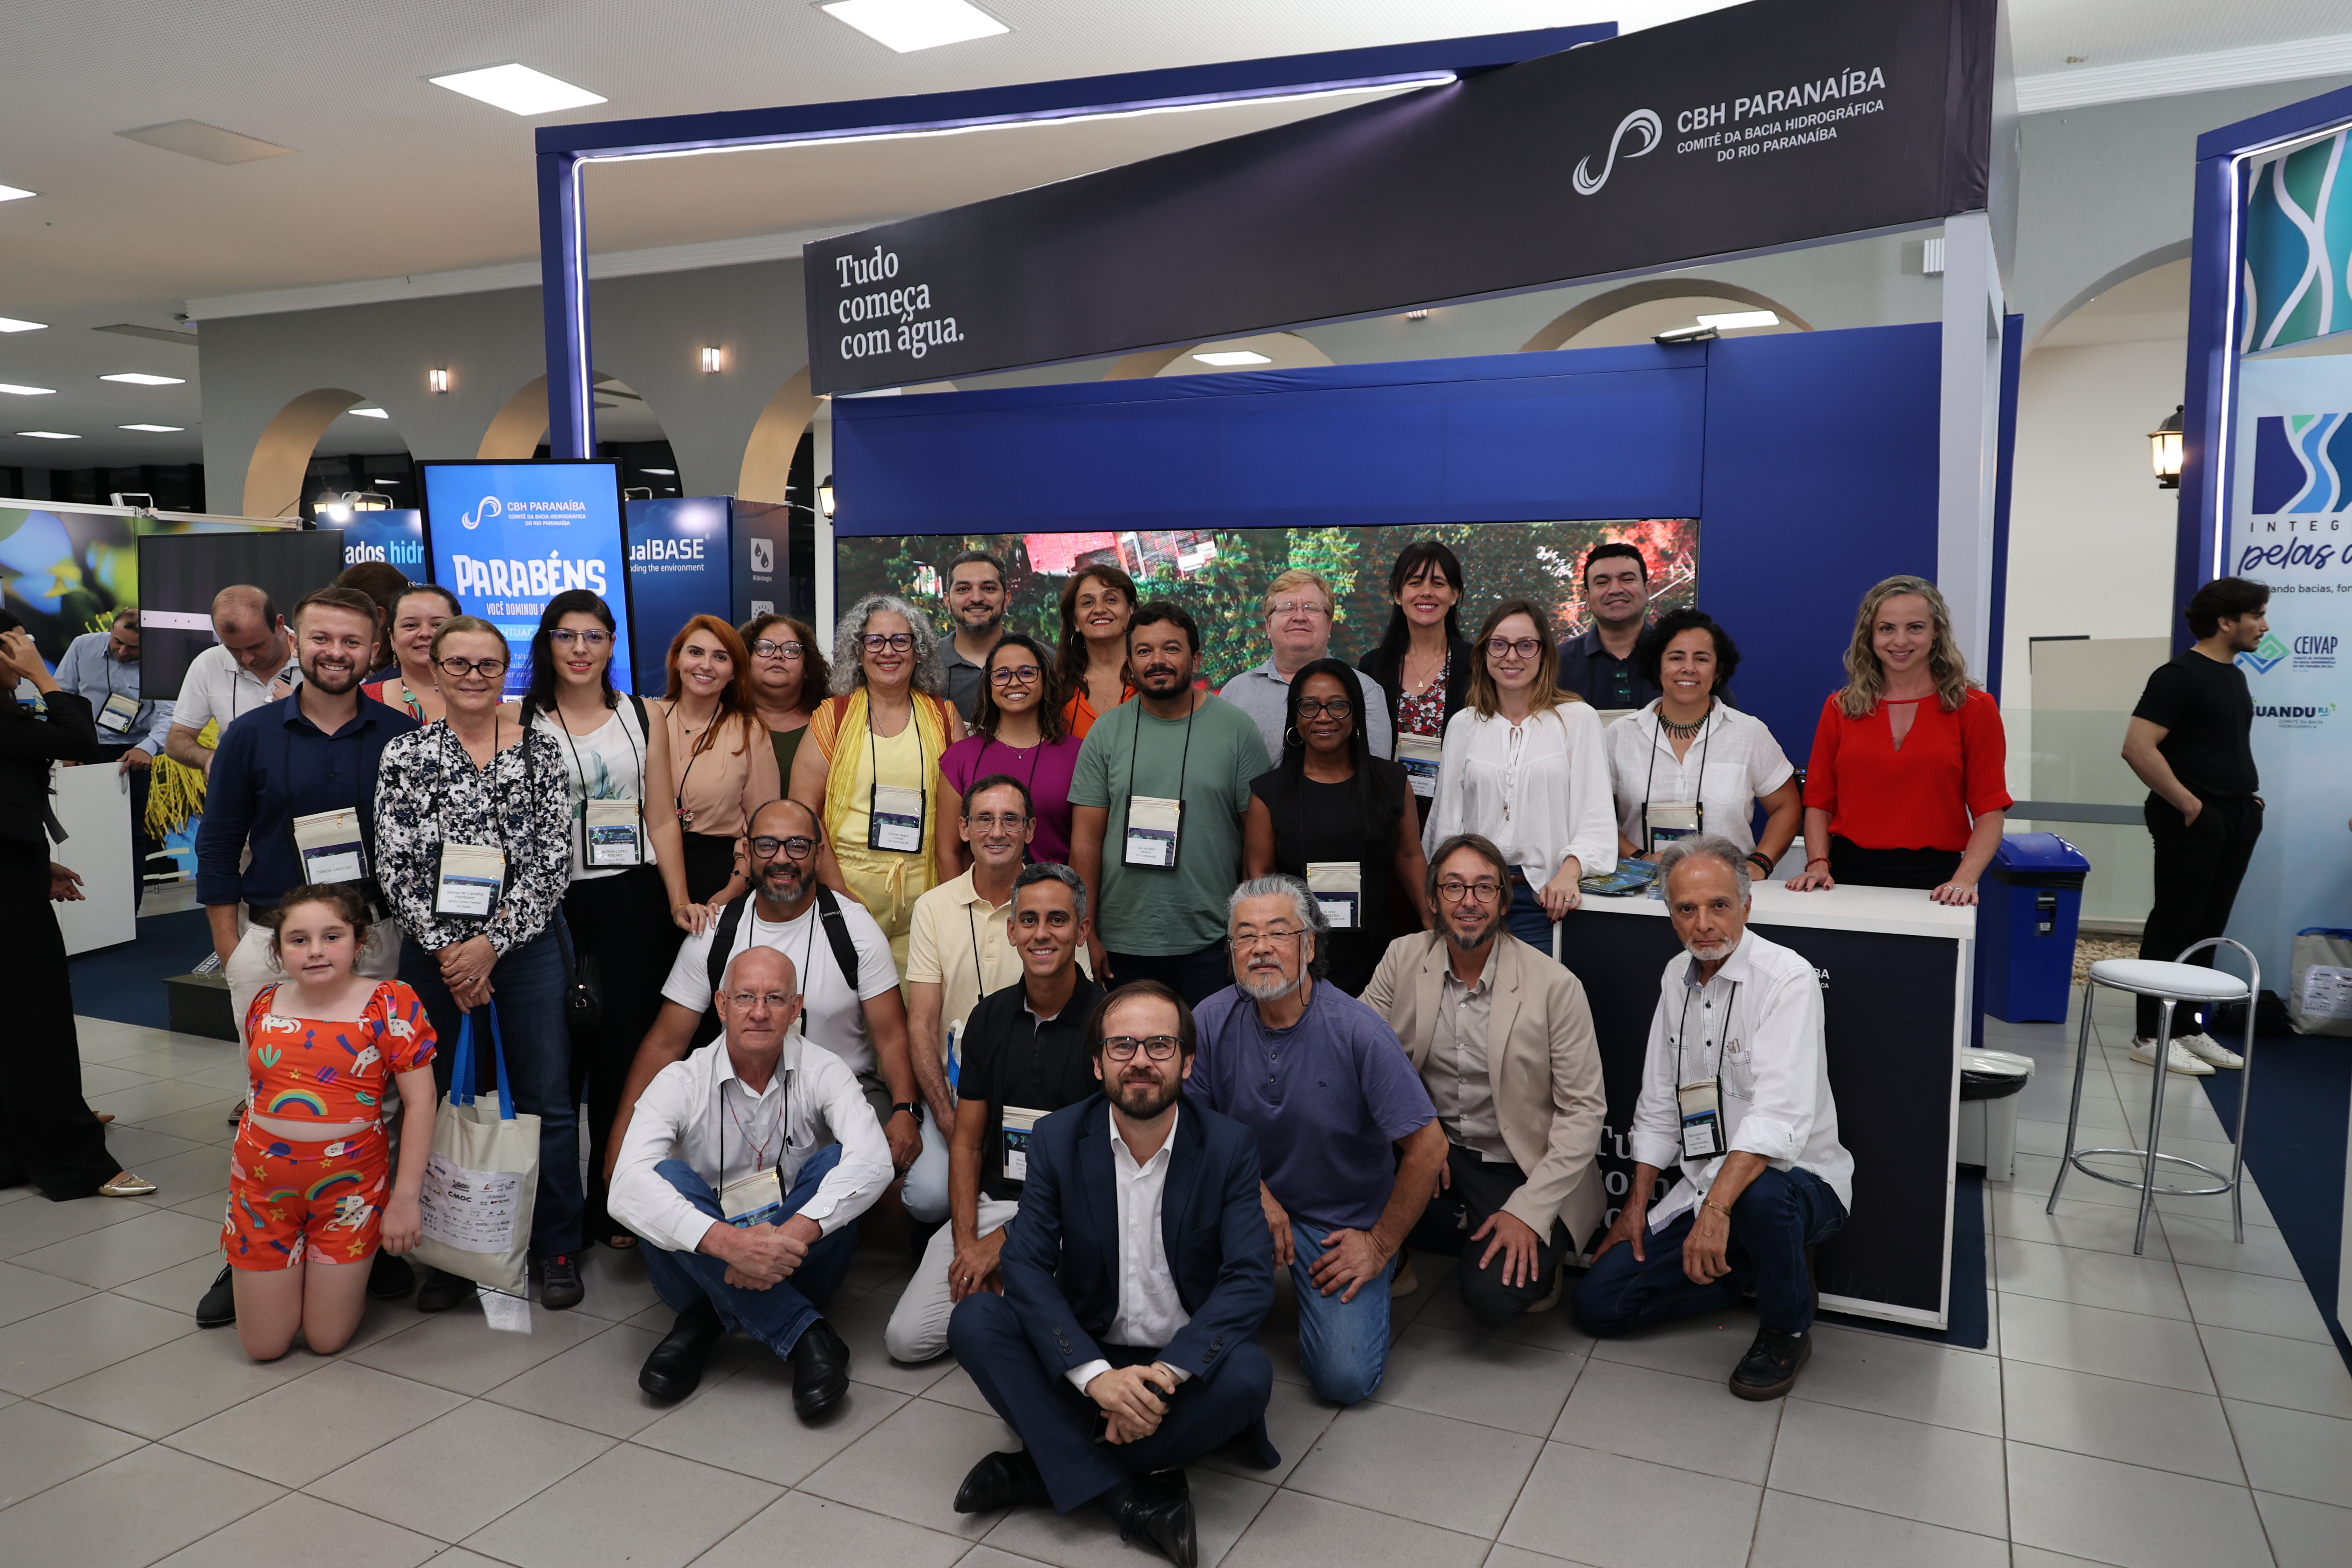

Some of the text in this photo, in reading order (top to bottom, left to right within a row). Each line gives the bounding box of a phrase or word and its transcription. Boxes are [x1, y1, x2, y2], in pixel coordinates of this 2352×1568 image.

[1677, 66, 1886, 133] CBH PARANAÍBA
[1677, 99, 1885, 153] COMITÊ DA BACIA HIDROGRÁFICA
[1717, 126, 1838, 162] DO RIO PARANAÍBA
[836, 245, 899, 288] Tudo
[839, 283, 931, 324] começa
[841, 312, 965, 359] com água.
[507, 499, 586, 511] CBH PARANAÍBA
[2250, 520, 2340, 533] INTEG
[345, 540, 424, 564] ados hidr
[629, 539, 704, 560] ualBASE
[2237, 536, 2336, 576] pelas
[452, 549, 607, 598] PARABÉNS
[648, 563, 659, 572] the
[660, 563, 704, 572] environment
[2271, 584, 2296, 593] ando
[486, 600, 505, 616] VOCÊ
[505, 603, 539, 616] DOMINOU
[2294, 636, 2338, 654] CEIVAP
[2255, 706, 2316, 718] UANDU
[447, 1191, 472, 1203] CMOC
